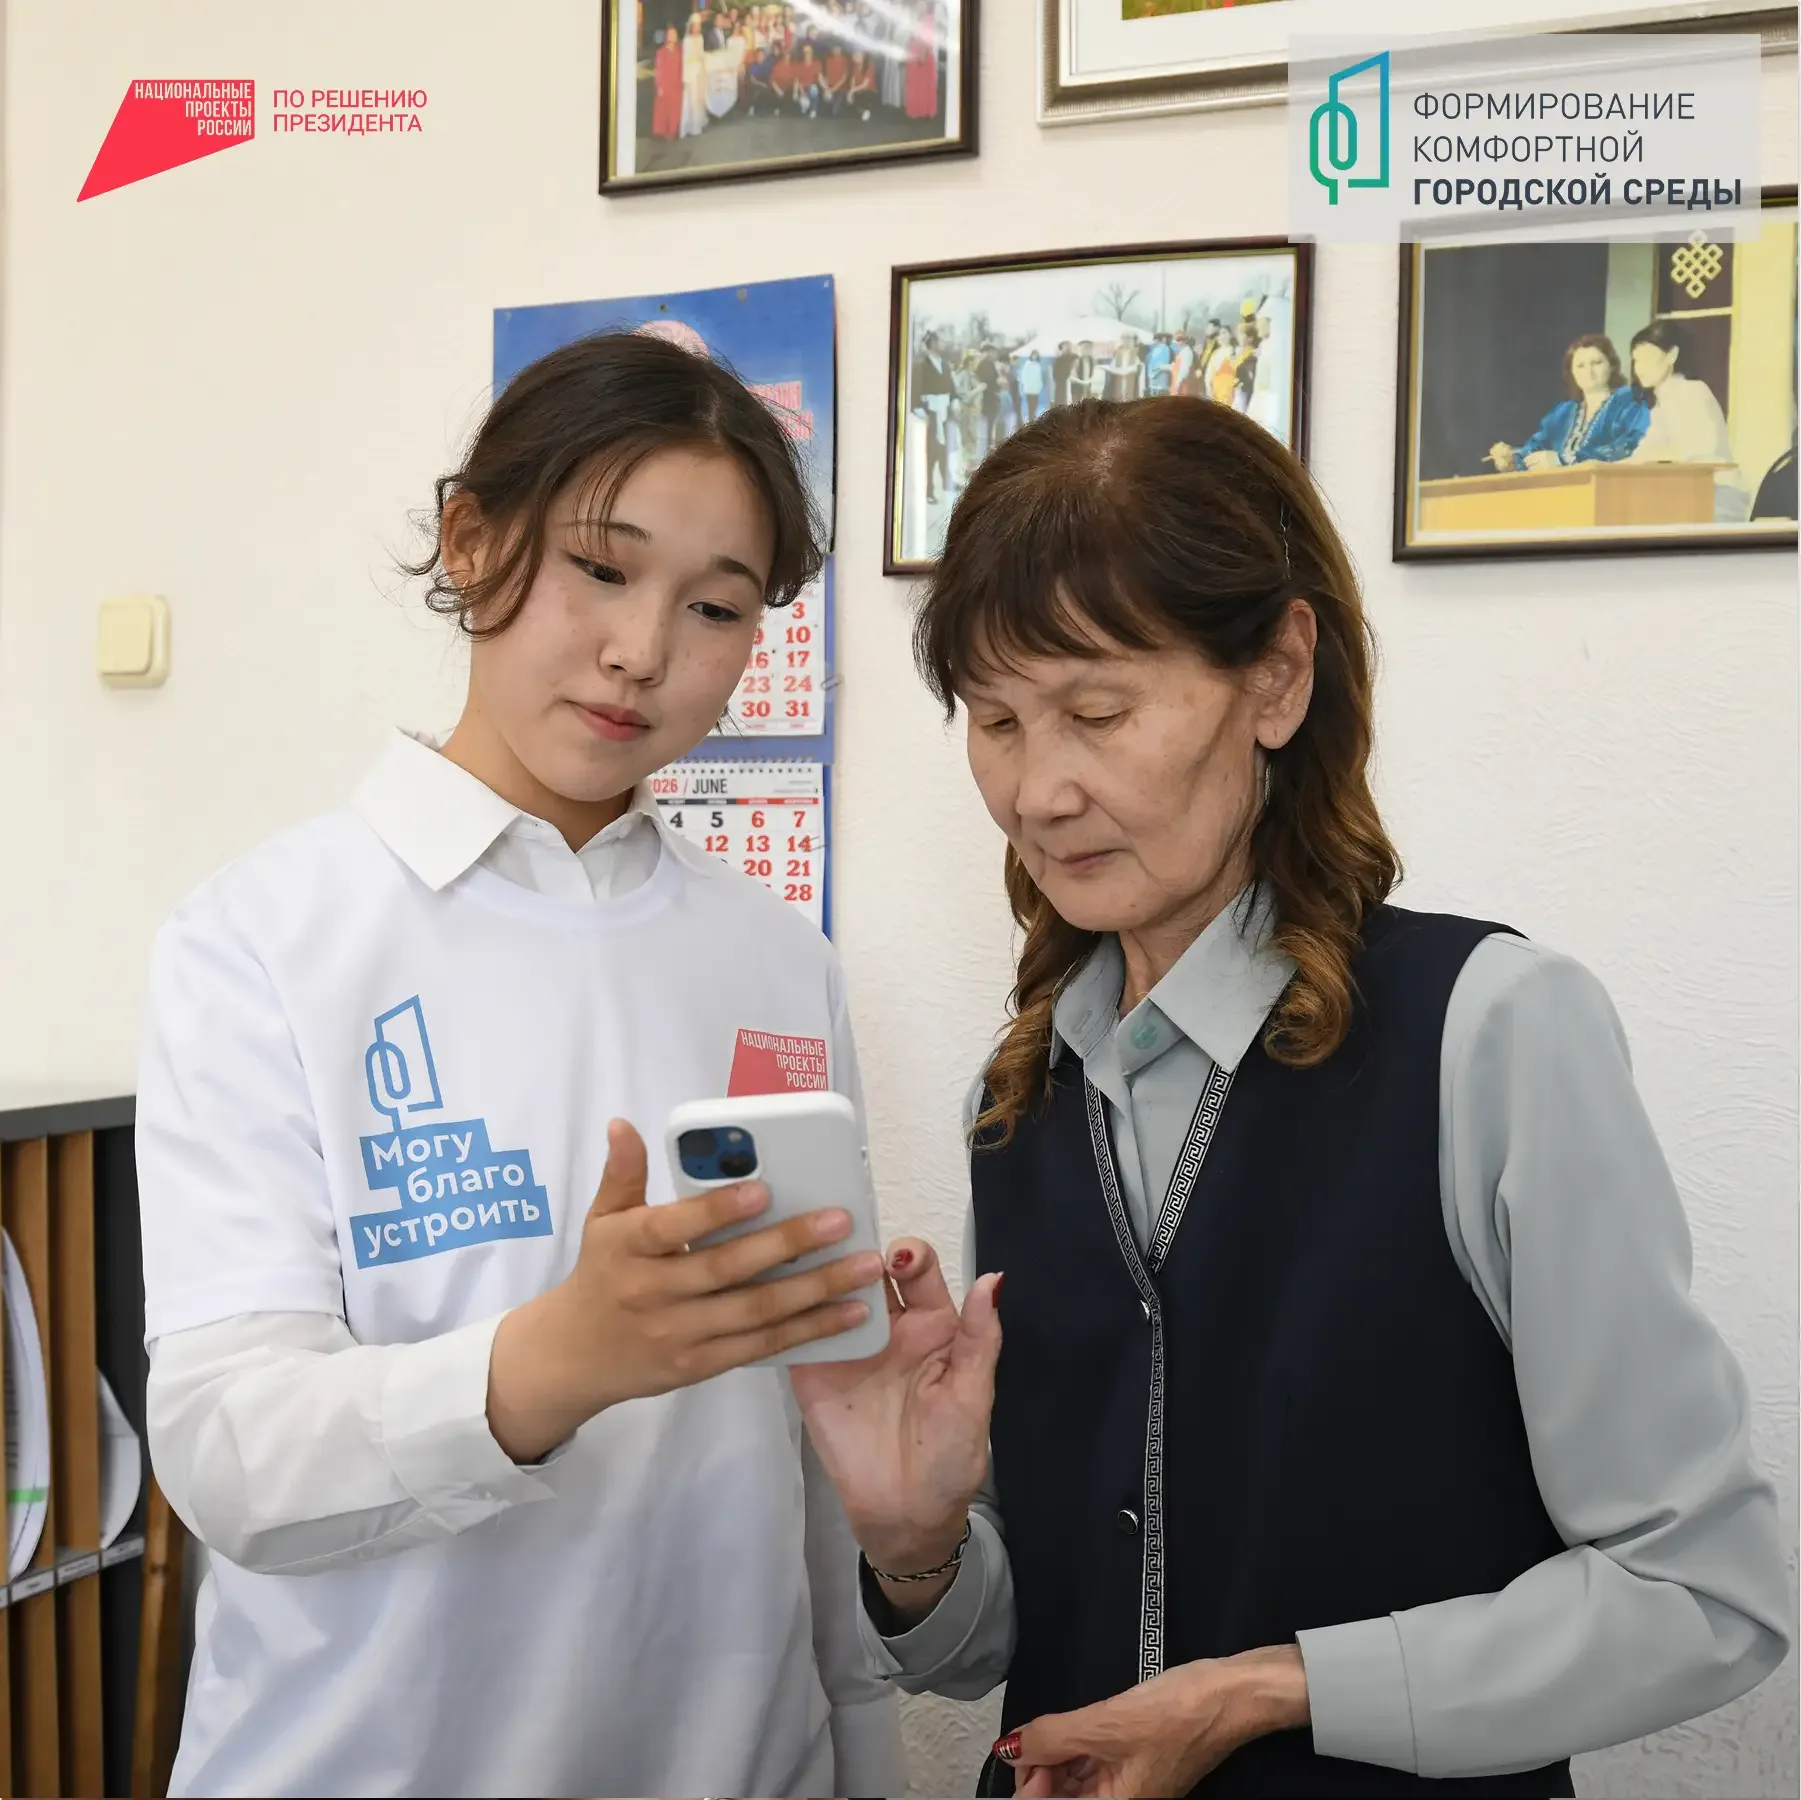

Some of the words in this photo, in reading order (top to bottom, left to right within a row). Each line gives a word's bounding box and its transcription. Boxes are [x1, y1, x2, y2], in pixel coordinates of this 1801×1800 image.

[791, 601, 806, 619] 3
[785, 625, 812, 643] 10
[786, 650, 810, 668] 17
[743, 676, 771, 693] 23
[783, 675, 812, 693] 24
[742, 700, 771, 717] 30
[785, 700, 810, 717] 31
[649, 778, 678, 794] 026
[692, 778, 727, 794] JUNE
[669, 811, 684, 828] 4
[710, 811, 724, 828] 5
[751, 810, 765, 828] 6
[793, 811, 806, 828] 7
[705, 835, 729, 852] 12
[746, 835, 770, 852] 13
[787, 835, 812, 852] 14
[743, 859, 772, 877] 20
[786, 859, 811, 877] 21
[784, 883, 812, 901] 28
[740, 1031, 825, 1057] НАЦИОНАЛЬНЫЕ
[776, 1053, 825, 1073] ПРОЕКТЫ
[786, 1071, 827, 1090] РОССИИ
[370, 1131, 473, 1171] Могу
[407, 1164, 525, 1203] благо
[363, 1199, 540, 1259] устроить
